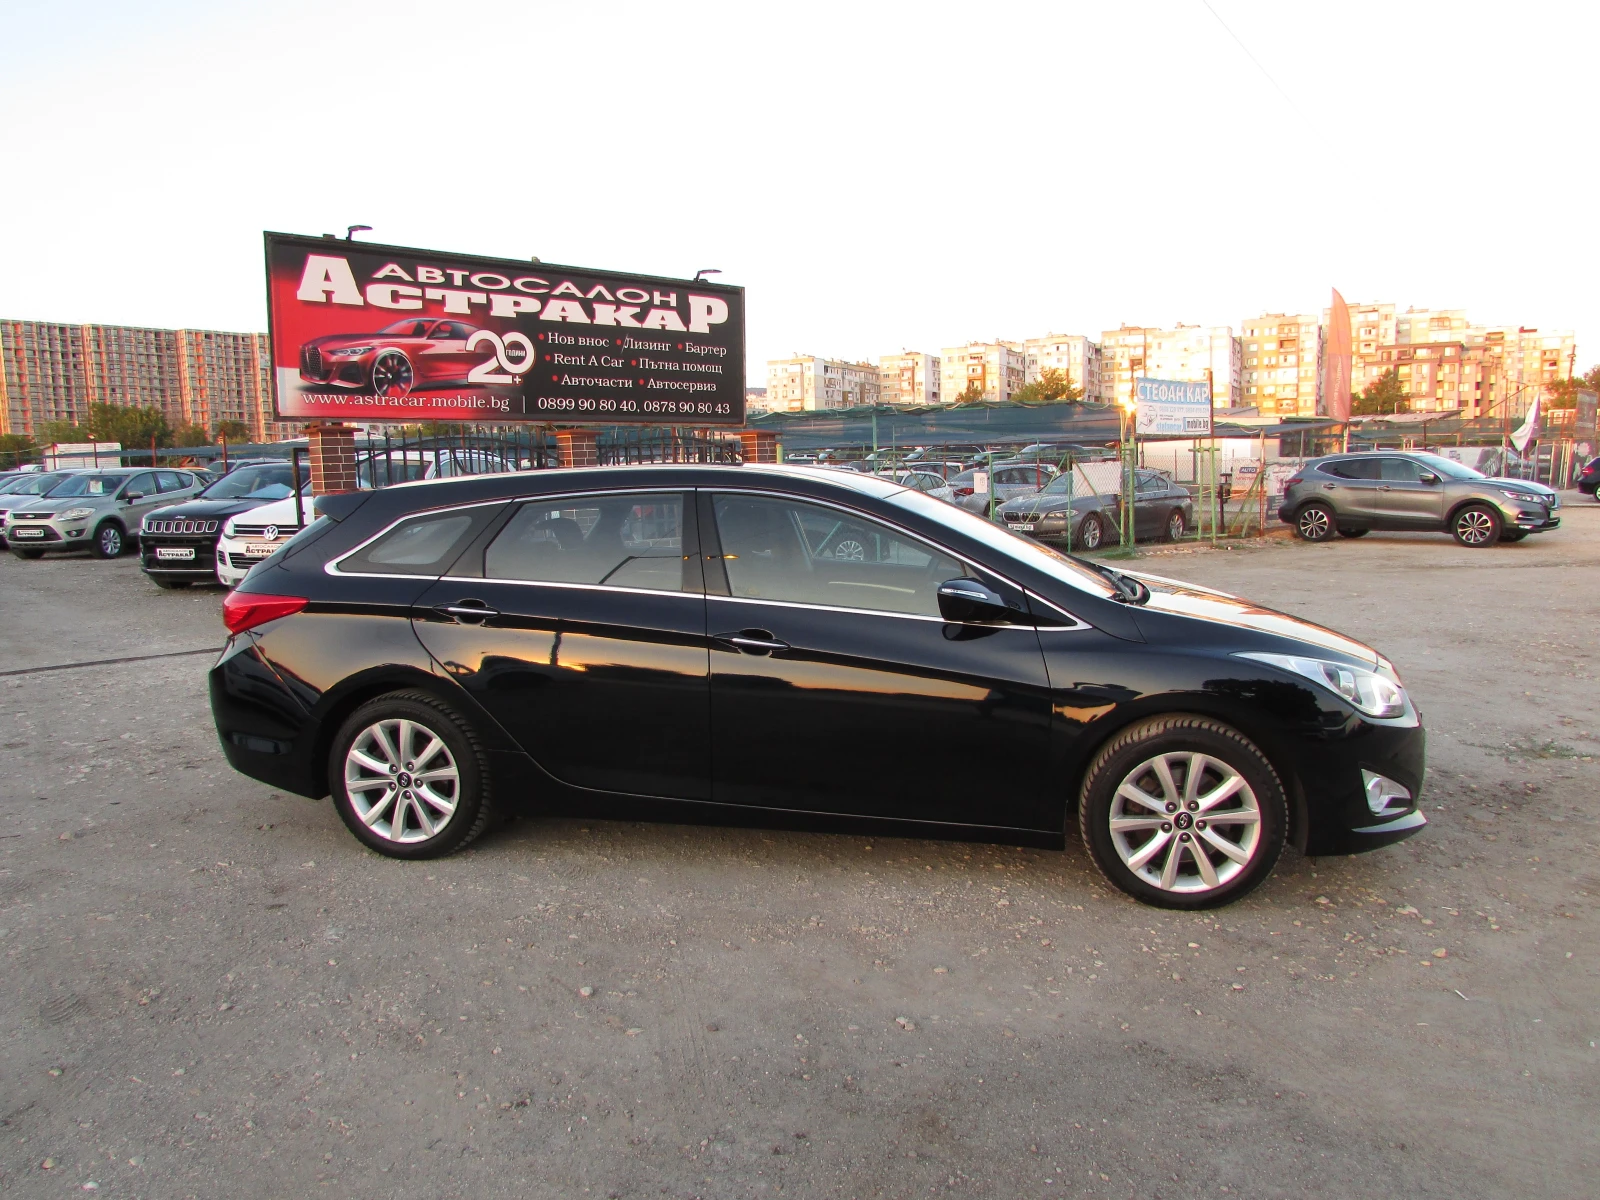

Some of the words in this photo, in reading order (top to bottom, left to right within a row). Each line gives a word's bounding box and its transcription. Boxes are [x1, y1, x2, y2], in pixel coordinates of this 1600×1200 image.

[296, 254, 729, 334] АСТРАКАР
[372, 263, 677, 307] АВТОСАЛОН
[547, 331, 575, 345] Нов
[578, 337, 610, 348] внос
[624, 337, 672, 352] Лизинг
[685, 342, 727, 357] Бартер
[554, 353, 586, 366] Rent
[588, 355, 598, 366] A
[601, 356, 625, 368] Car
[639, 357, 680, 371] Пътна
[682, 363, 723, 375] помощ
[561, 374, 633, 388] Авточасти
[647, 378, 717, 393] Автосервиз
[1137, 382, 1184, 402] СТЕФАН
[1187, 386, 1209, 403] КАР
[302, 393, 510, 412] www.astracar.mobile.bg
[538, 397, 575, 410] 0899
[578, 399, 596, 411] 90
[599, 400, 617, 411] 80
[643, 401, 676, 413] 0878
[679, 402, 695, 413] 90
[697, 402, 713, 414] 80
[715, 403, 731, 414] 43
[1186, 419, 1209, 429] mobile.bg
